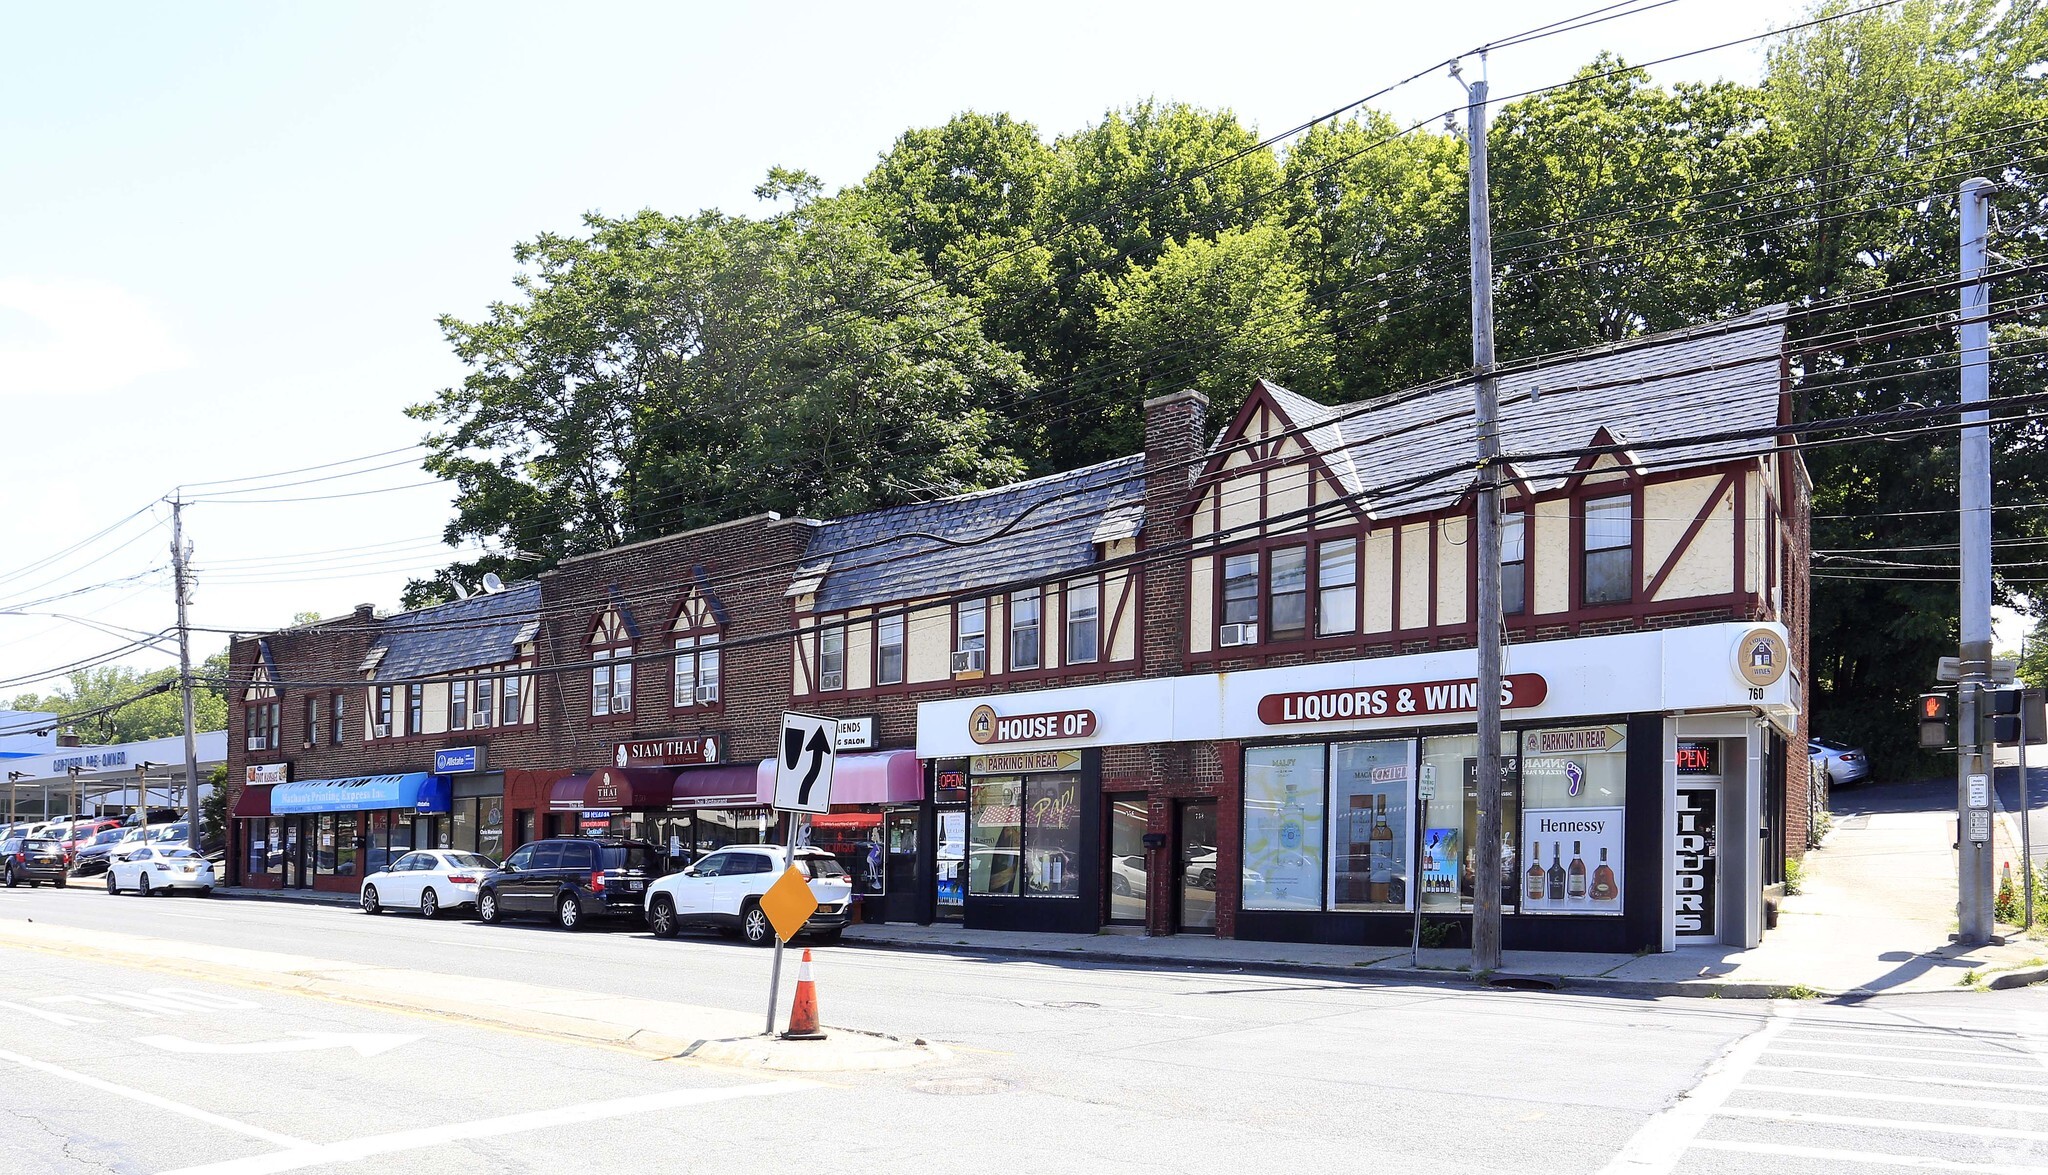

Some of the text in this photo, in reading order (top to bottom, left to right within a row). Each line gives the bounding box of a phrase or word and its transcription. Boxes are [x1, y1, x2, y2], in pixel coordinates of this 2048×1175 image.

[1283, 680, 1514, 721] LIQUORS & WINS
[1748, 687, 1764, 701] 760
[997, 713, 1089, 741] HOUSE OF
[843, 738, 866, 746] SALON
[1542, 730, 1606, 751] PARKING IN REAR
[632, 740, 698, 758] SIAM THAI
[446, 756, 464, 767] Allstate
[988, 754, 1058, 770] PARKING IN REAR
[940, 773, 963, 788] OPEN
[597, 788, 618, 797] THAI
[1540, 818, 1606, 834] Hennessy
